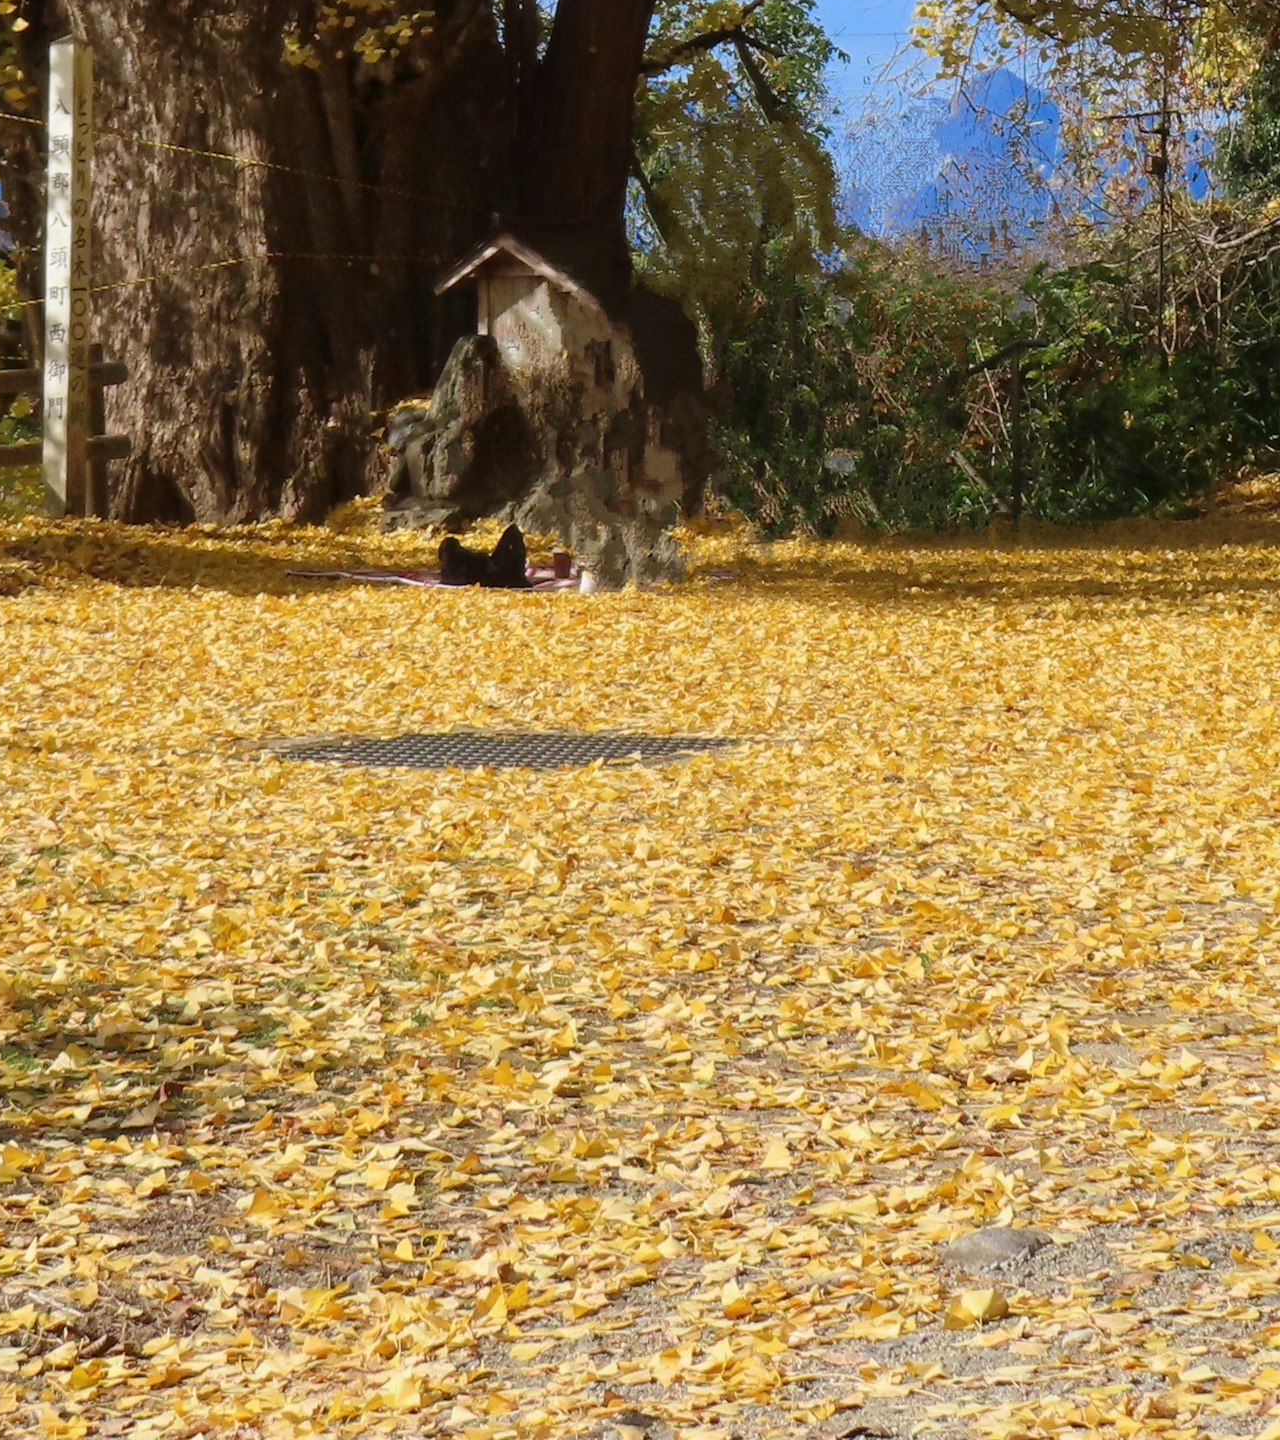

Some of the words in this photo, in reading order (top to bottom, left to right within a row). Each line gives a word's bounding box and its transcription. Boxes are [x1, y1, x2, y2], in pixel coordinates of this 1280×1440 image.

[48, 98, 71, 421] 八頭郡八頭町西御門
